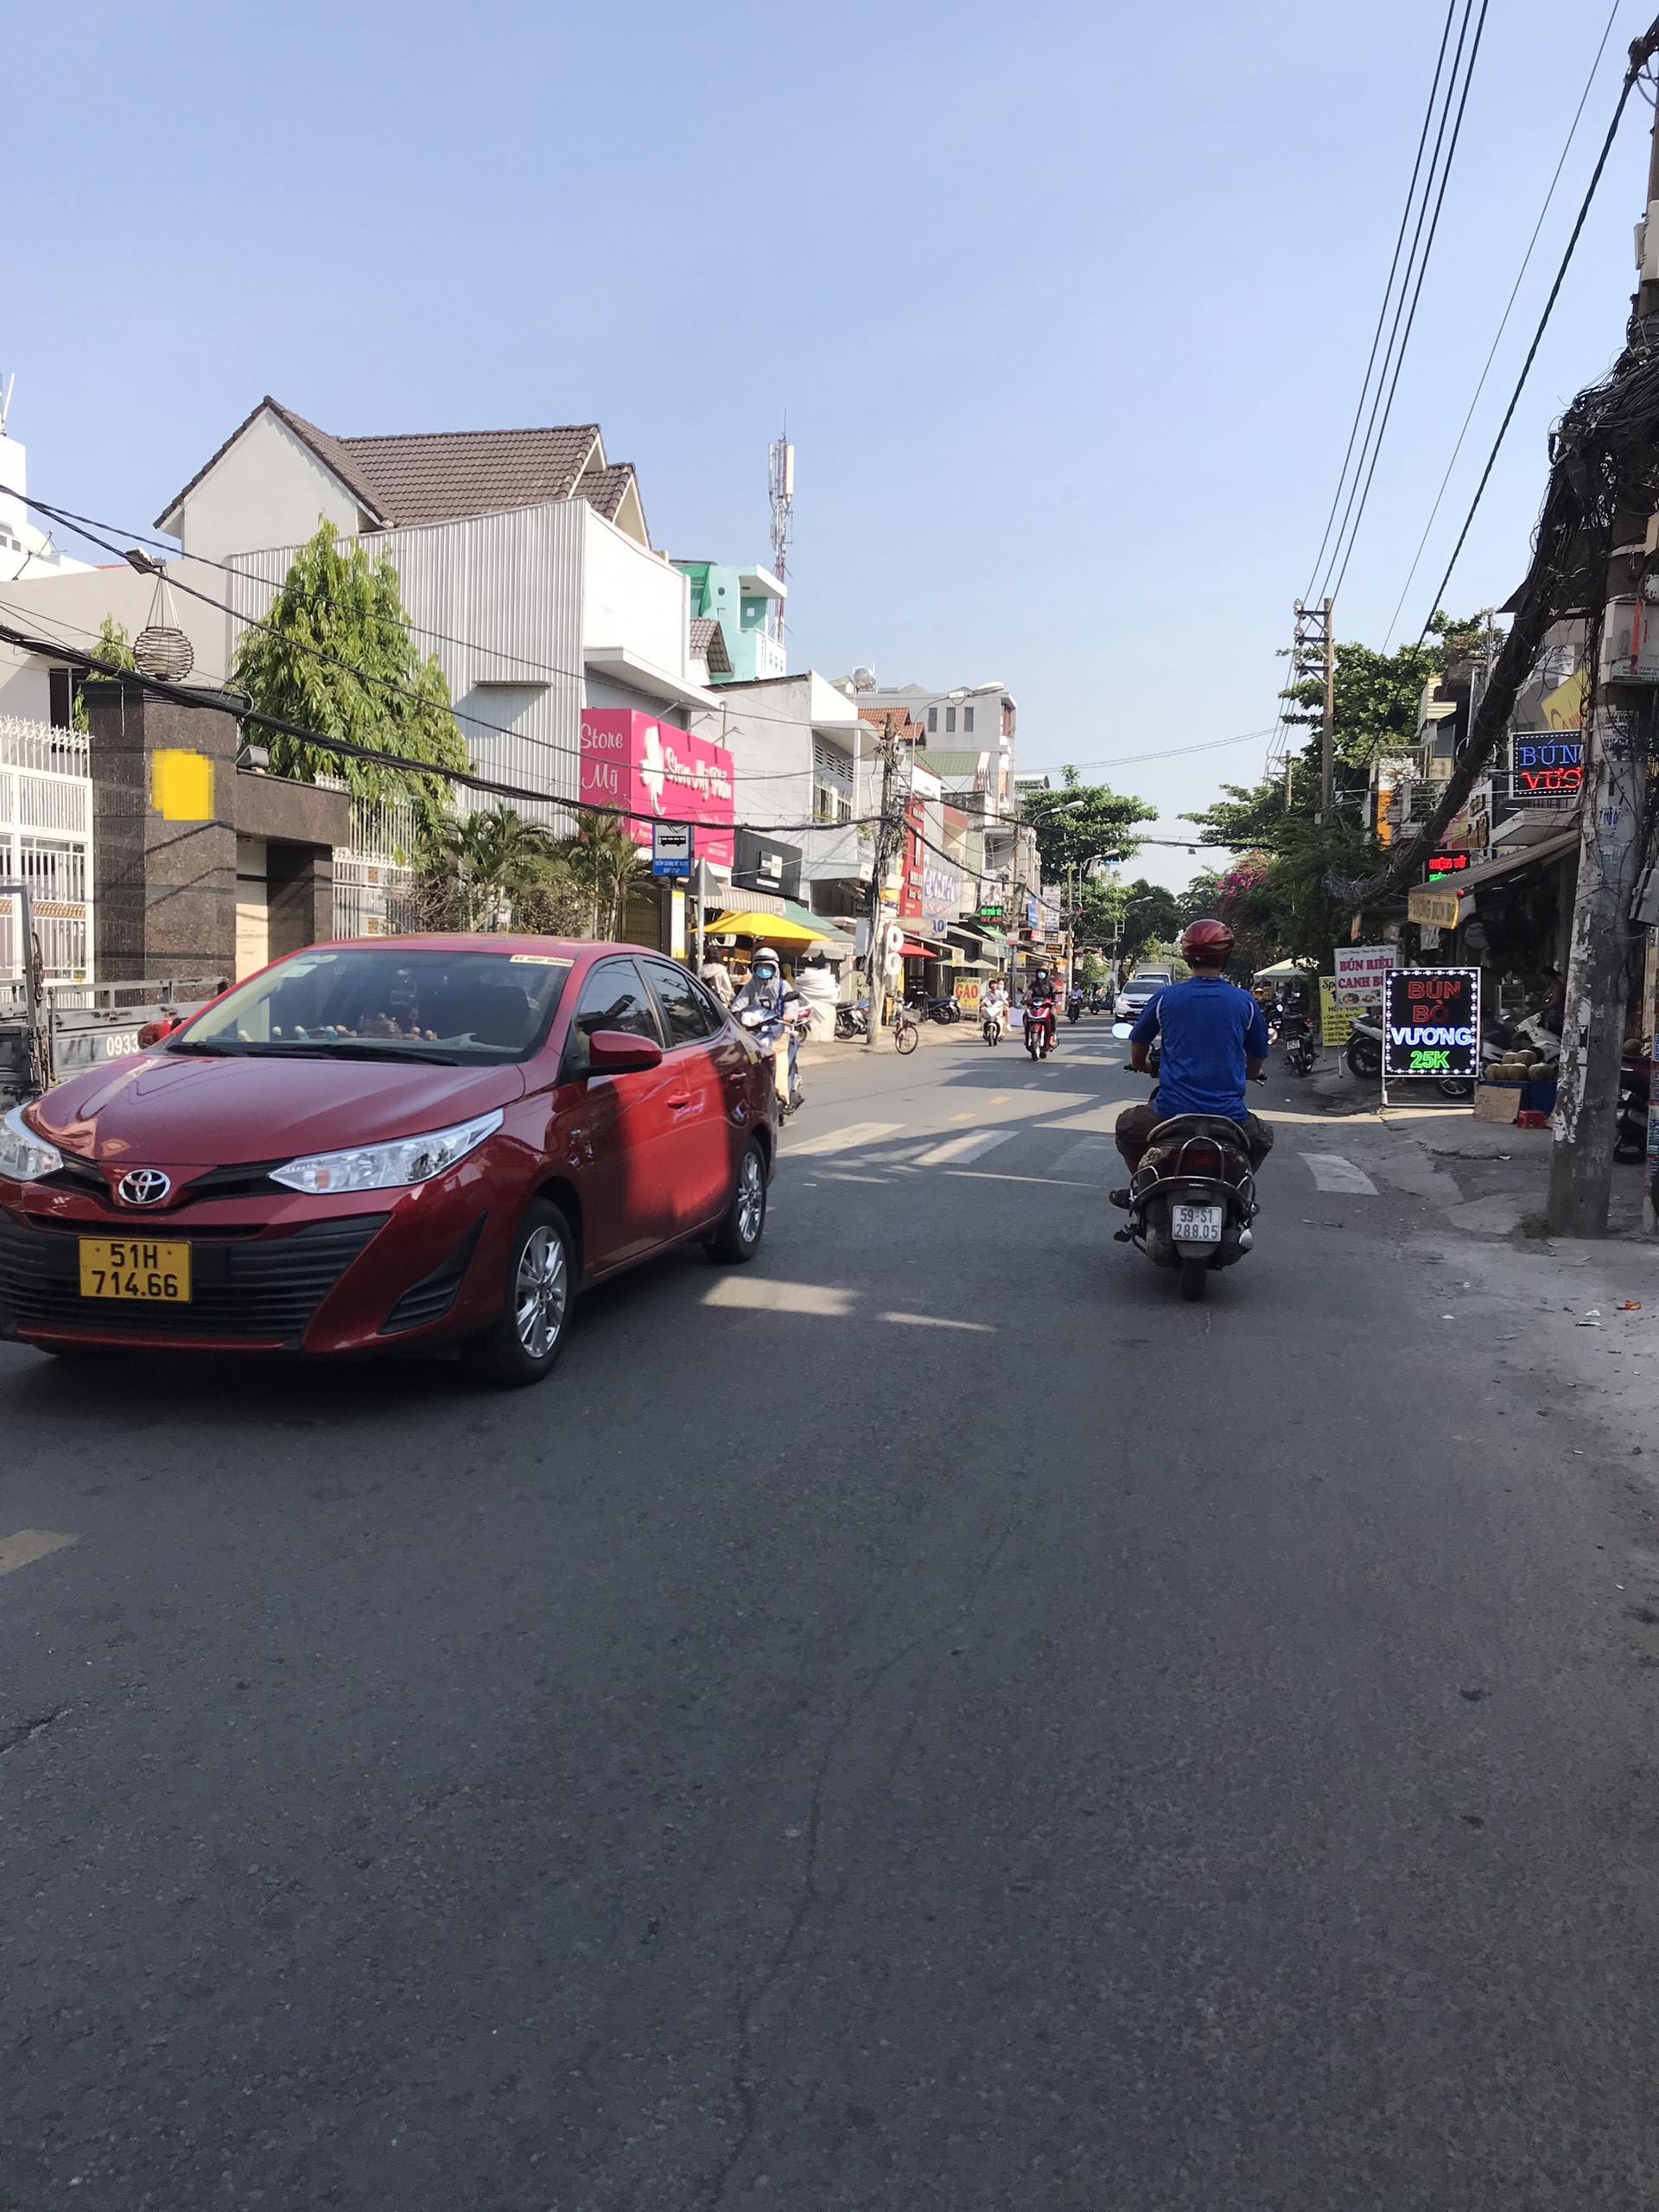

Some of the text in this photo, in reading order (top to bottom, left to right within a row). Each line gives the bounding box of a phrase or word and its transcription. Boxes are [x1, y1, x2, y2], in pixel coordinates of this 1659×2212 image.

[581, 723, 623, 750] Store
[1519, 739, 1581, 767] BÚN
[582, 764, 619, 796] Mỹ
[1521, 766, 1582, 791] VƯƠ
[1339, 957, 1363, 972] BÚN
[1338, 976, 1370, 989] CANH
[1408, 976, 1461, 1000] BÚN
[1412, 1000, 1450, 1024] BÒ
[106, 1033, 140, 1057] 0933
[1390, 1027, 1472, 1046] VƯƠNG
[1409, 1050, 1451, 1069] 25K
[1175, 1224, 1218, 1239] 288.05
[111, 1243, 158, 1269] 51H
[92, 1270, 179, 1298] 714.66
